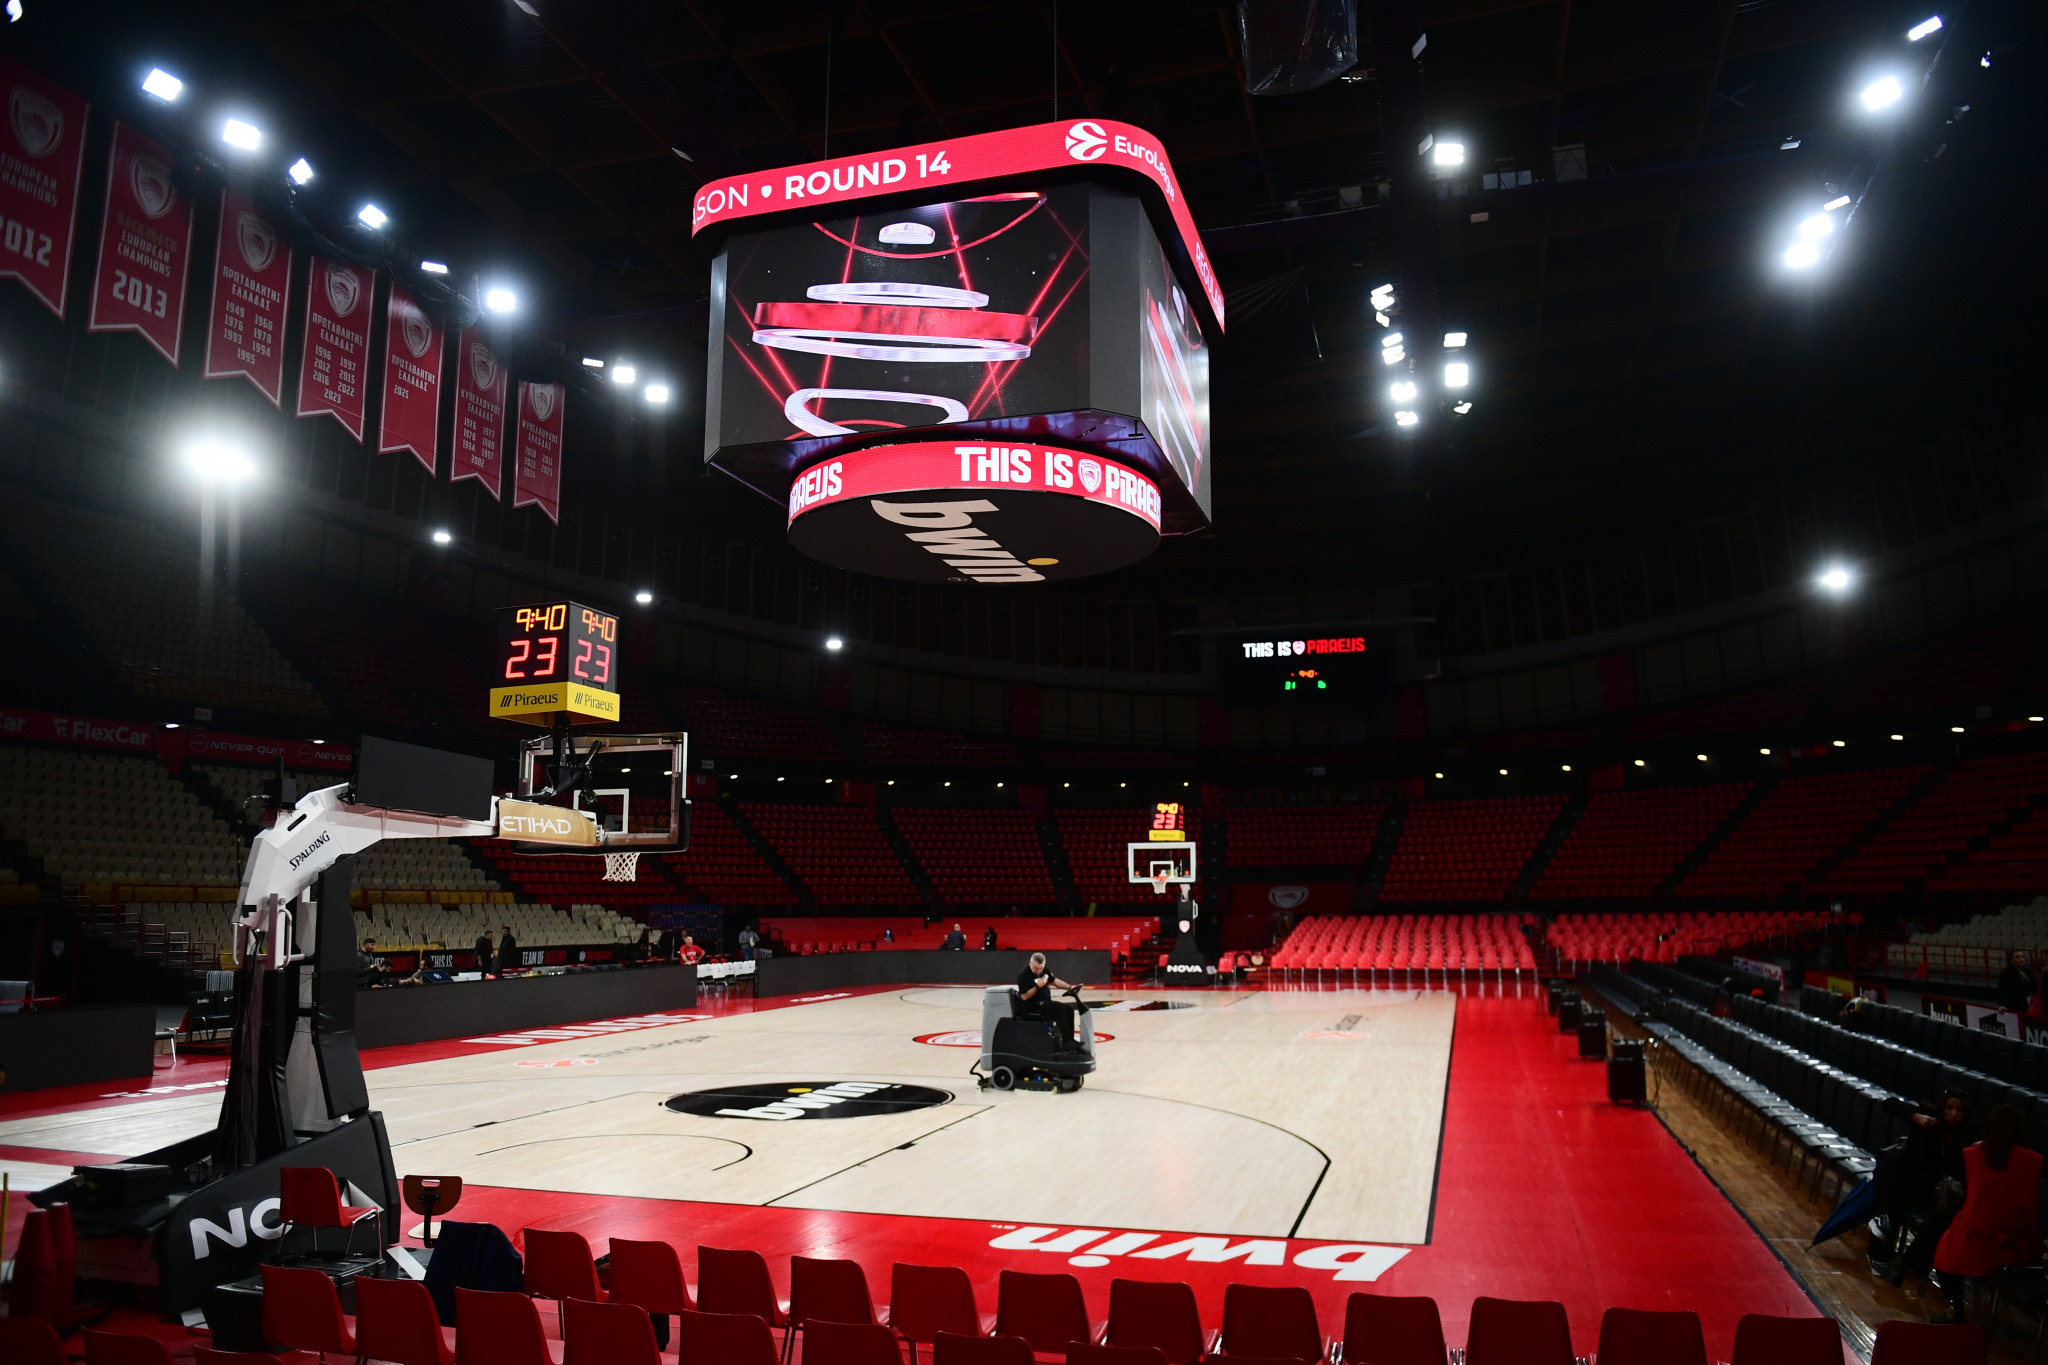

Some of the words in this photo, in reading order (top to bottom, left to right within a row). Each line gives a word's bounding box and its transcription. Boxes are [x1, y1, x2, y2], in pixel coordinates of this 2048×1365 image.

[1, 152, 58, 192] EUROPEAN
[1115, 135, 1175, 202] EuroLeague
[0, 166, 58, 208] HAMPIONS
[693, 184, 748, 225] SON
[785, 158, 906, 200] ROUND
[915, 150, 951, 180] 14
[117, 242, 171, 278] CHAMPIONS
[121, 228, 170, 264] EUROPEAN
[112, 269, 168, 318] 2013
[226, 301, 245, 318] 1949
[223, 328, 242, 345] 1993
[252, 341, 271, 357] 1994
[225, 314, 244, 331] 1976
[253, 328, 272, 344] 1978
[237, 348, 256, 365] 1995
[314, 357, 331, 373] 2012
[339, 369, 355, 385] 2015
[315, 344, 332, 360] 1996
[340, 356, 356, 372] 1997
[312, 370, 329, 386] 2016
[337, 381, 354, 397] 2022
[324, 388, 341, 404] 2023
[393, 384, 409, 399] 2025
[954, 446, 1032, 483] THIS
[1044, 452, 1074, 488] IS
[871, 498, 1059, 583] bwin
[516, 604, 567, 632] 9:40
[581, 608, 616, 642] 9:40
[505, 637, 558, 678] 23
[573, 638, 611, 683] 23
[1242, 641, 1274, 658] THIS
[1277, 641, 1292, 657] IS
[1307, 637, 1365, 655] PIRAEUS
[514, 692, 559, 707] Piraeus
[584, 693, 614, 713] Piraeus
[0, 712, 26, 733] ar
[72, 719, 150, 746] FlexCar
[209, 740, 253, 753] NEVER
[256, 745, 286, 755] QUIT
[314, 751, 353, 762] NEVER
[500, 815, 572, 835] ETIHAD
[1153, 813, 1176, 829] 23
[289, 830, 331, 871] SPALDING
[1166, 964, 1203, 973] NOVA
[714, 1082, 892, 1121] bwin
[189, 1198, 293, 1260] NO
[989, 1226, 1412, 1282] bwin
